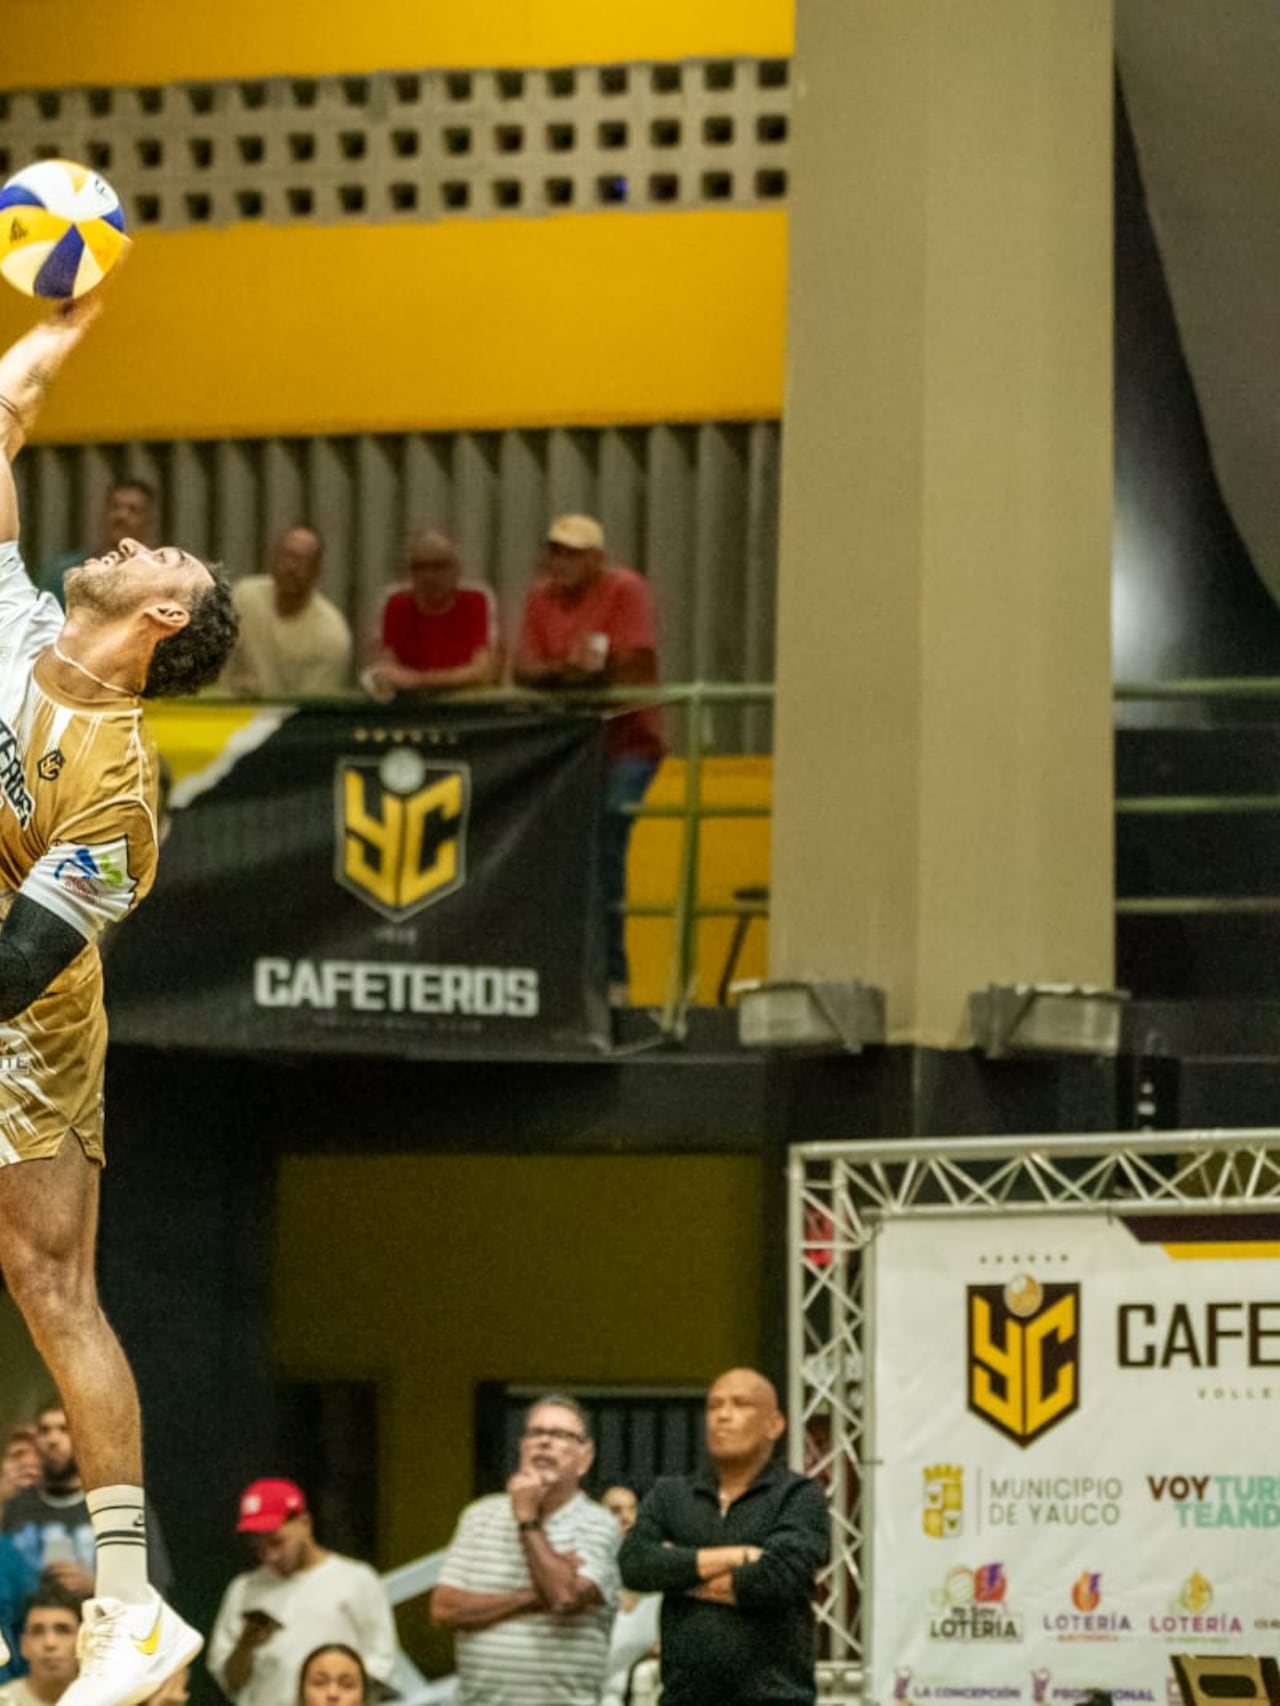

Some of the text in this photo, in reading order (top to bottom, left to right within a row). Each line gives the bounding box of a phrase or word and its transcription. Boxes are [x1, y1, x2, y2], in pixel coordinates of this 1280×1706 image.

[254, 955, 540, 1018] CAFETEROS
[1117, 1301, 1280, 1369] CAFE
[989, 1476, 1124, 1501] MUNICIPIO
[1147, 1475, 1280, 1501] VOY TUR
[989, 1504, 1121, 1527] DE YAUCO
[1173, 1503, 1280, 1529] TEAND
[1149, 1614, 1243, 1633] LOTERÍA
